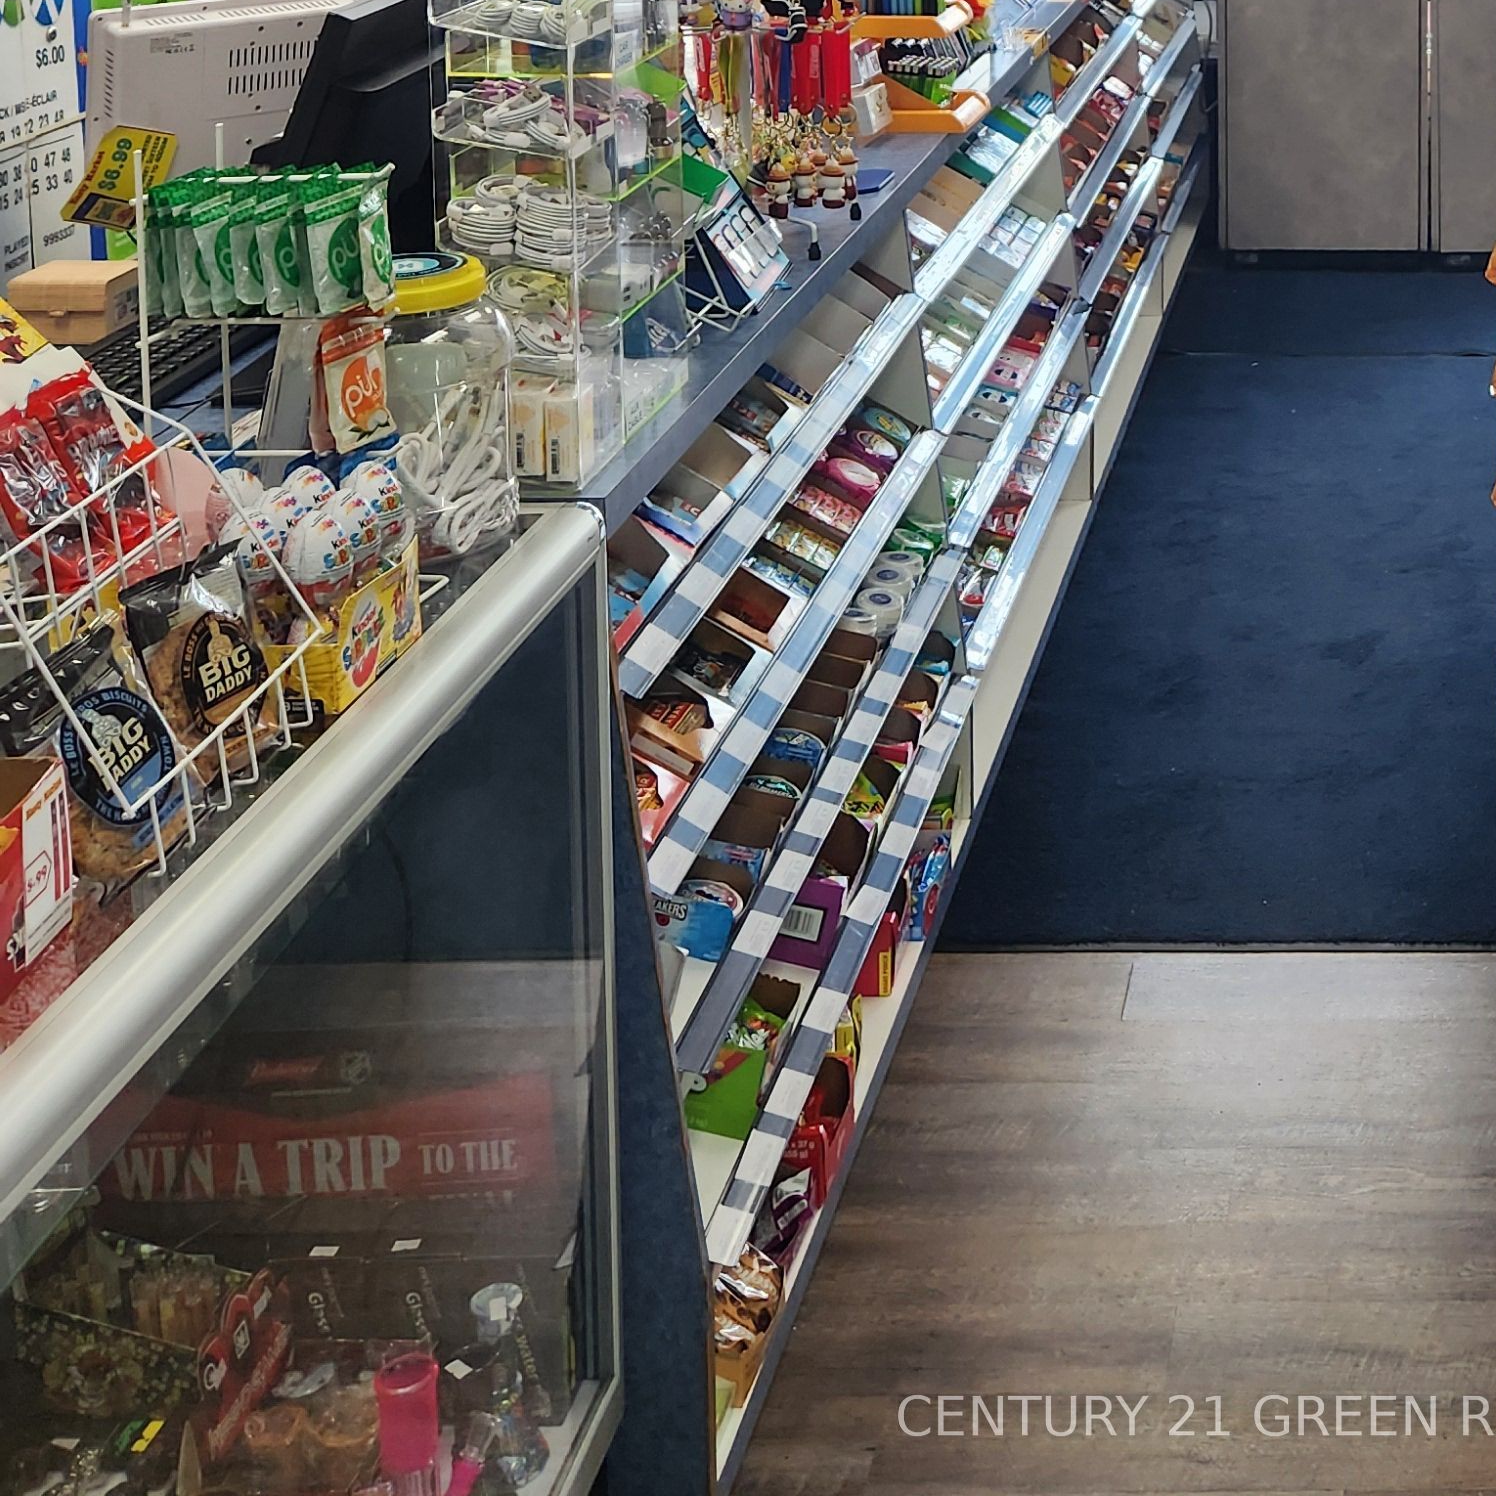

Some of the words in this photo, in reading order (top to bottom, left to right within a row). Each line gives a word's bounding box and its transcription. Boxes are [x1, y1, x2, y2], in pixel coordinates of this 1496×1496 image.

[35, 44, 65, 70] $6.00
[44, 151, 56, 169] 47
[45, 173, 58, 192] 33
[198, 644, 252, 689] BIG
[204, 664, 254, 704] DADDY
[113, 1144, 217, 1202] WIN
[234, 1142, 265, 1198] A
[276, 1134, 401, 1196] TRIP
[417, 1143, 455, 1175] TO
[460, 1138, 519, 1173] THE
